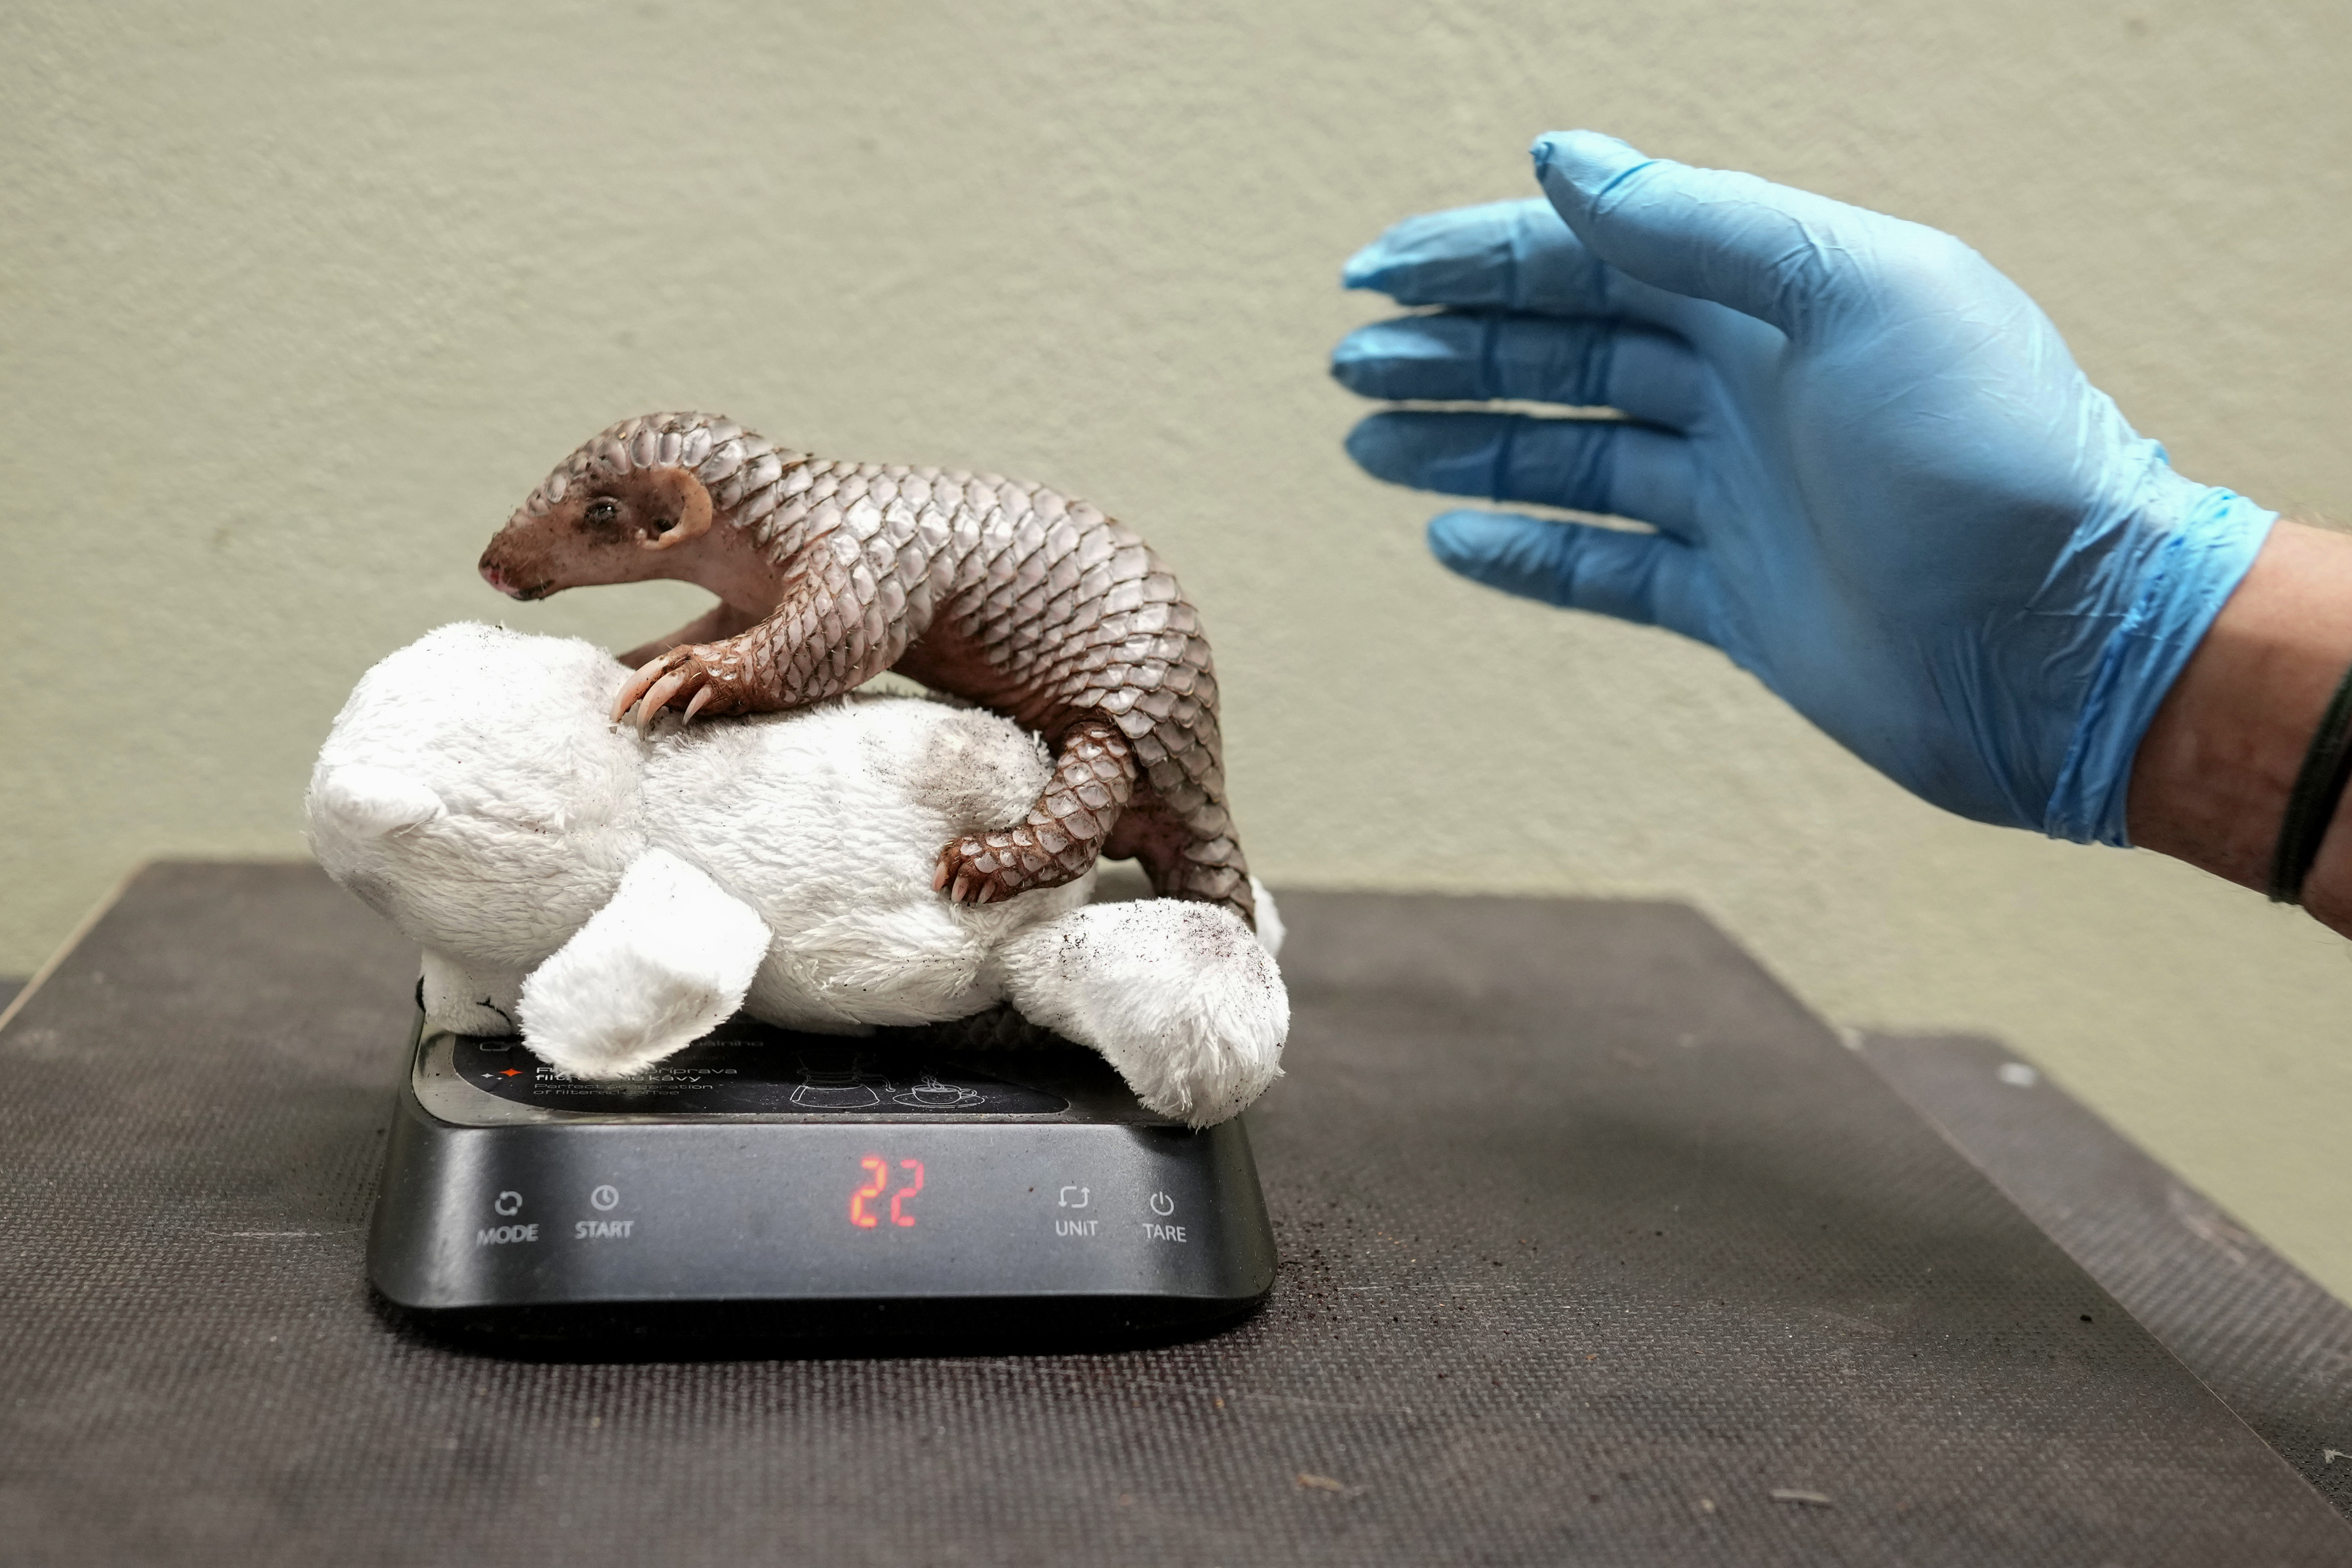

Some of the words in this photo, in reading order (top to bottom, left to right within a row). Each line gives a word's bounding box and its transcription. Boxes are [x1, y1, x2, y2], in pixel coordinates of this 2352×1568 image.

[851, 1158, 924, 1227] 22
[476, 1223, 539, 1245] MODE
[574, 1220, 634, 1240] START
[1055, 1220, 1098, 1237] UNIT
[1142, 1223, 1187, 1243] TARE
